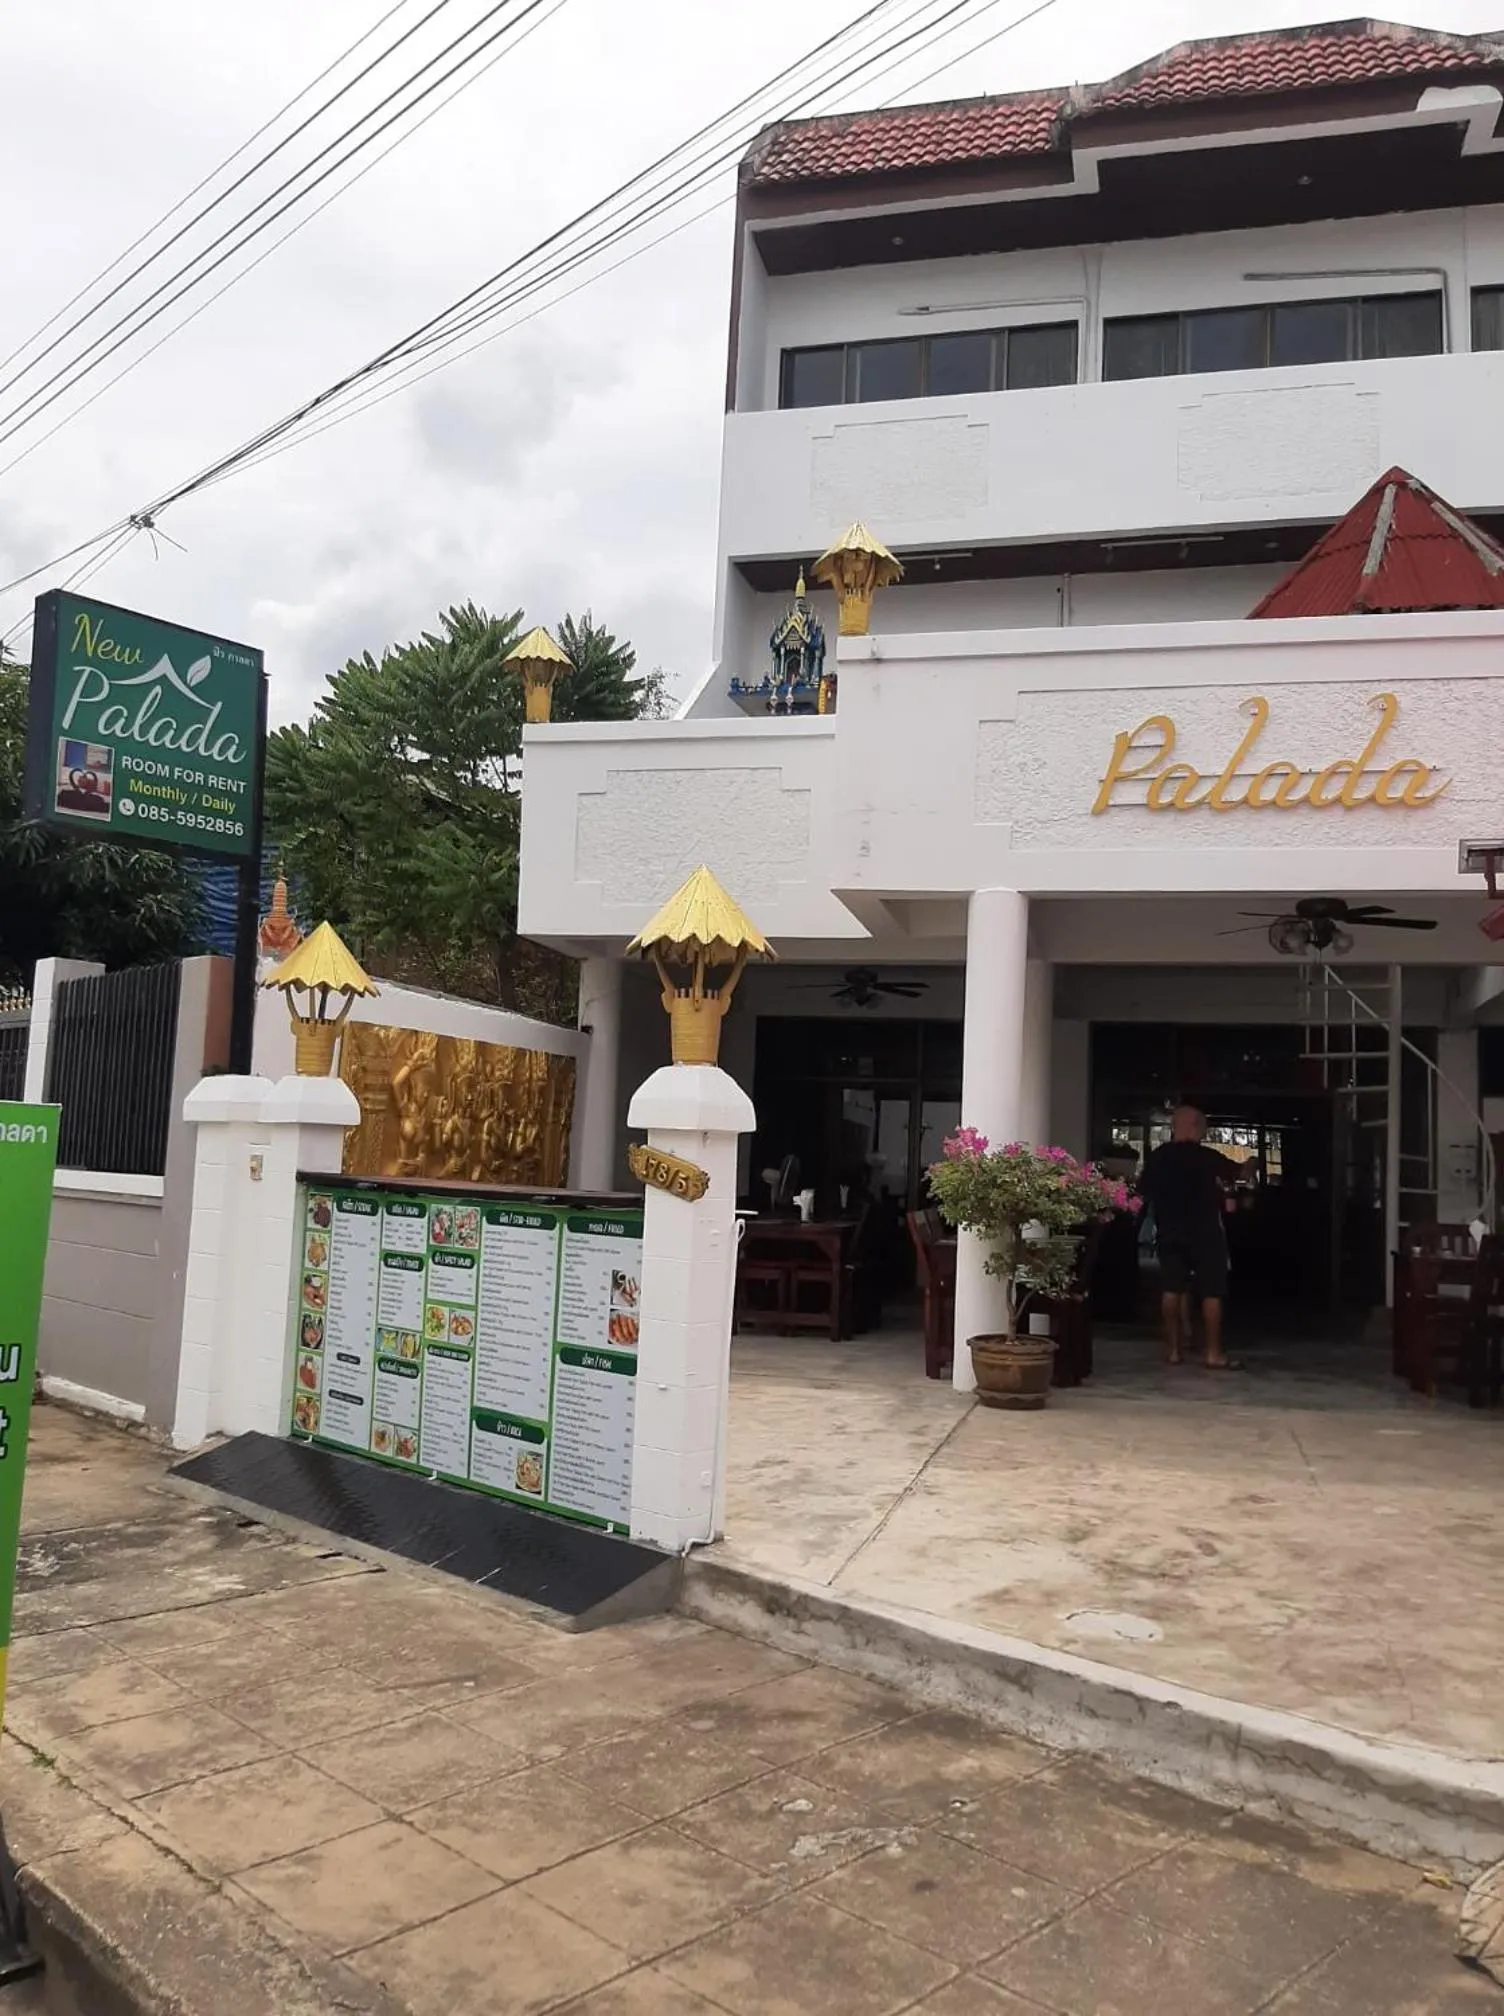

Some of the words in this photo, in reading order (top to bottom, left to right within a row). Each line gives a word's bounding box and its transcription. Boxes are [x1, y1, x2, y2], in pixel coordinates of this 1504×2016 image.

[71, 613, 143, 665] New
[62, 665, 247, 764] Palada
[122, 755, 169, 778] ROOM
[174, 768, 204, 786] FOR
[208, 774, 247, 795] RENT
[1091, 692, 1453, 815] Palada
[129, 778, 188, 805] Monthly
[202, 794, 236, 815] Daily
[138, 803, 244, 837] 085-5952856
